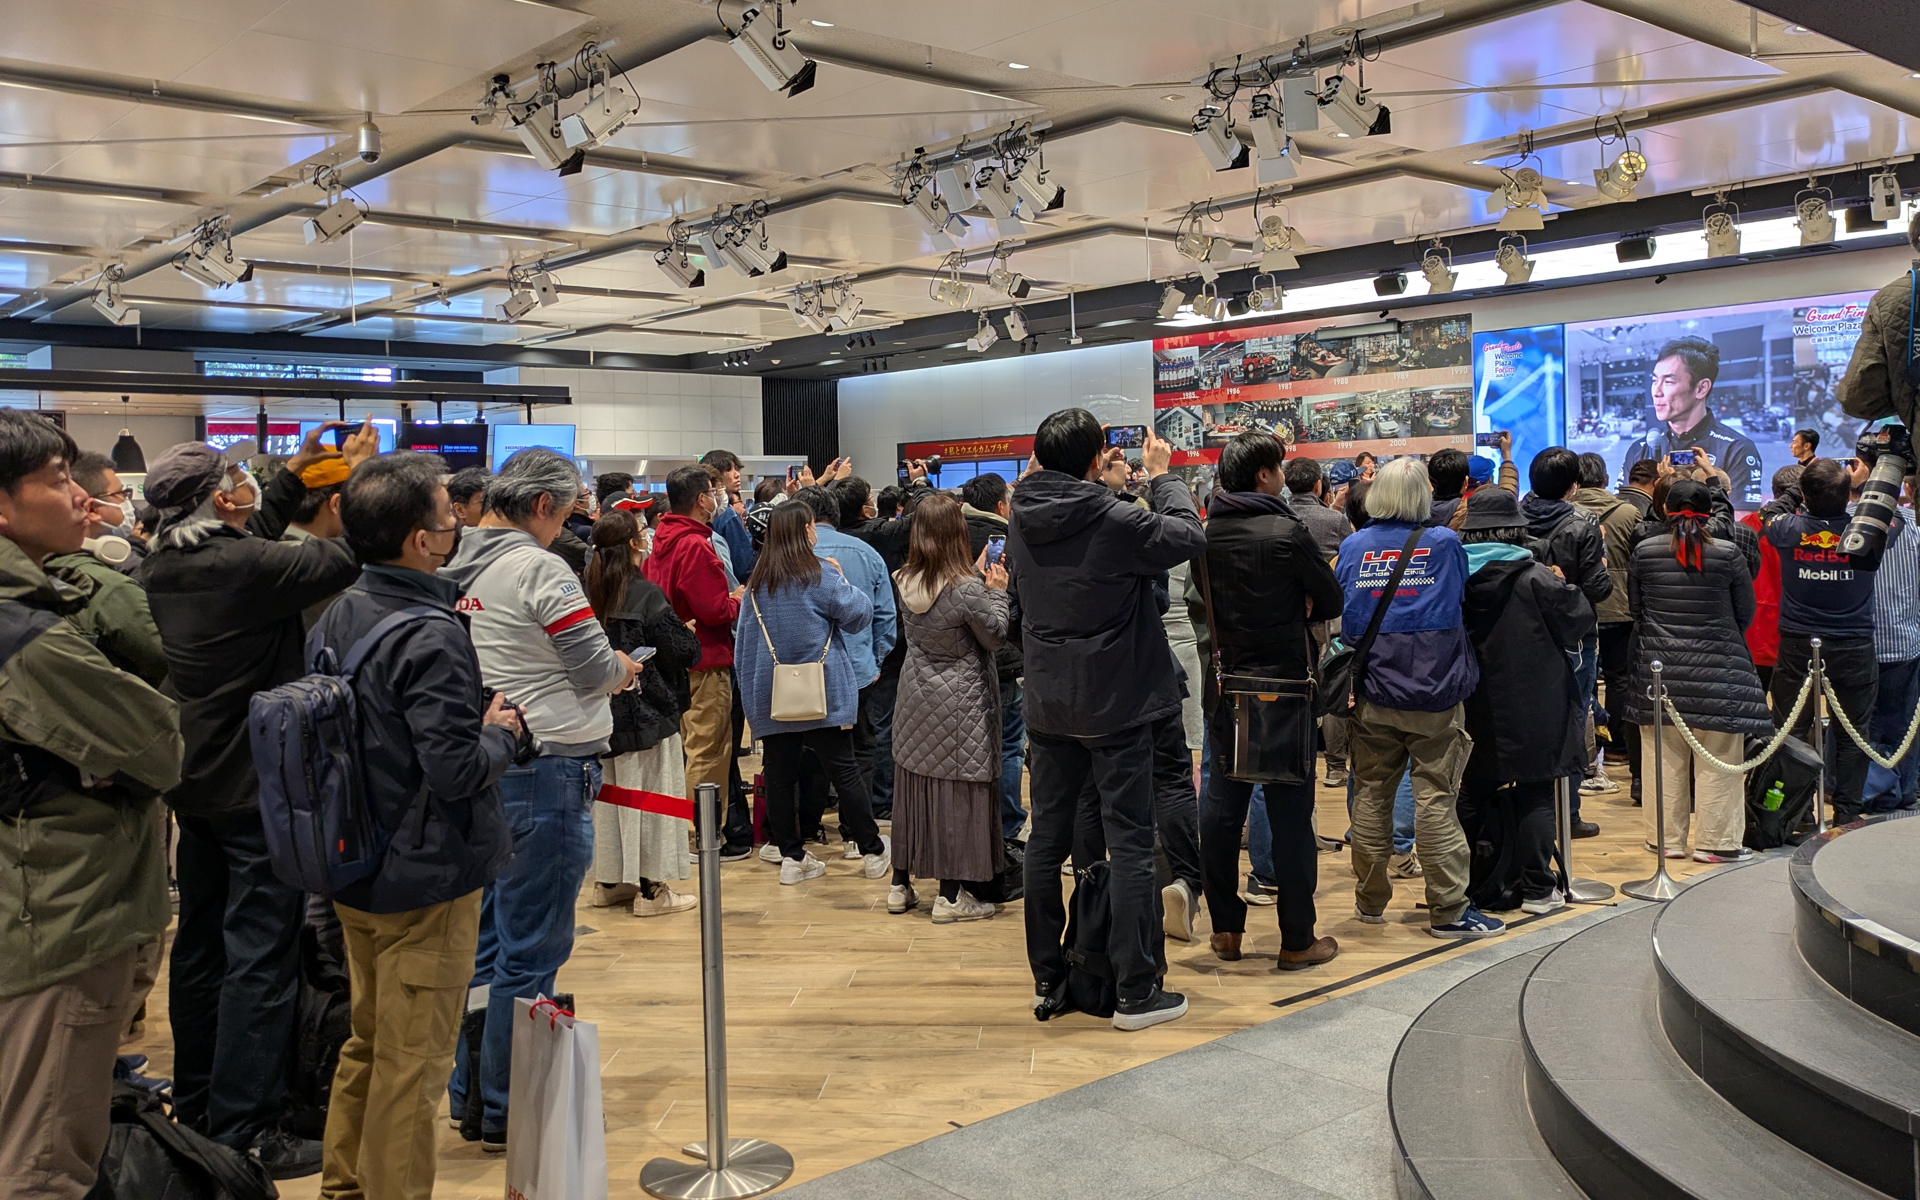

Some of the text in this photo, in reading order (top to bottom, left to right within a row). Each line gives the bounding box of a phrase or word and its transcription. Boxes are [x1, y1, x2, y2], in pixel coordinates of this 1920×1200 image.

[1806, 308, 1843, 322] Grand
[1795, 324, 1836, 335] Welcome
[1483, 341, 1522, 352] Grand Finale
[1494, 352, 1523, 360] Welcome
[1393, 372, 1409, 380] 1989
[1450, 367, 1468, 375] 1990
[1389, 439, 1407, 447] 2000
[1451, 435, 1468, 443] 2001
[1187, 450, 1200, 458] 1996
[1360, 548, 1431, 573] HRC
[1794, 548, 1850, 563] Red Bu
[1798, 568, 1838, 580] Mobil
[560, 582, 577, 594] IHI
[1372, 589, 1418, 597] HNDA
[455, 598, 485, 611] DA
[508, 1183, 528, 1200] HO
